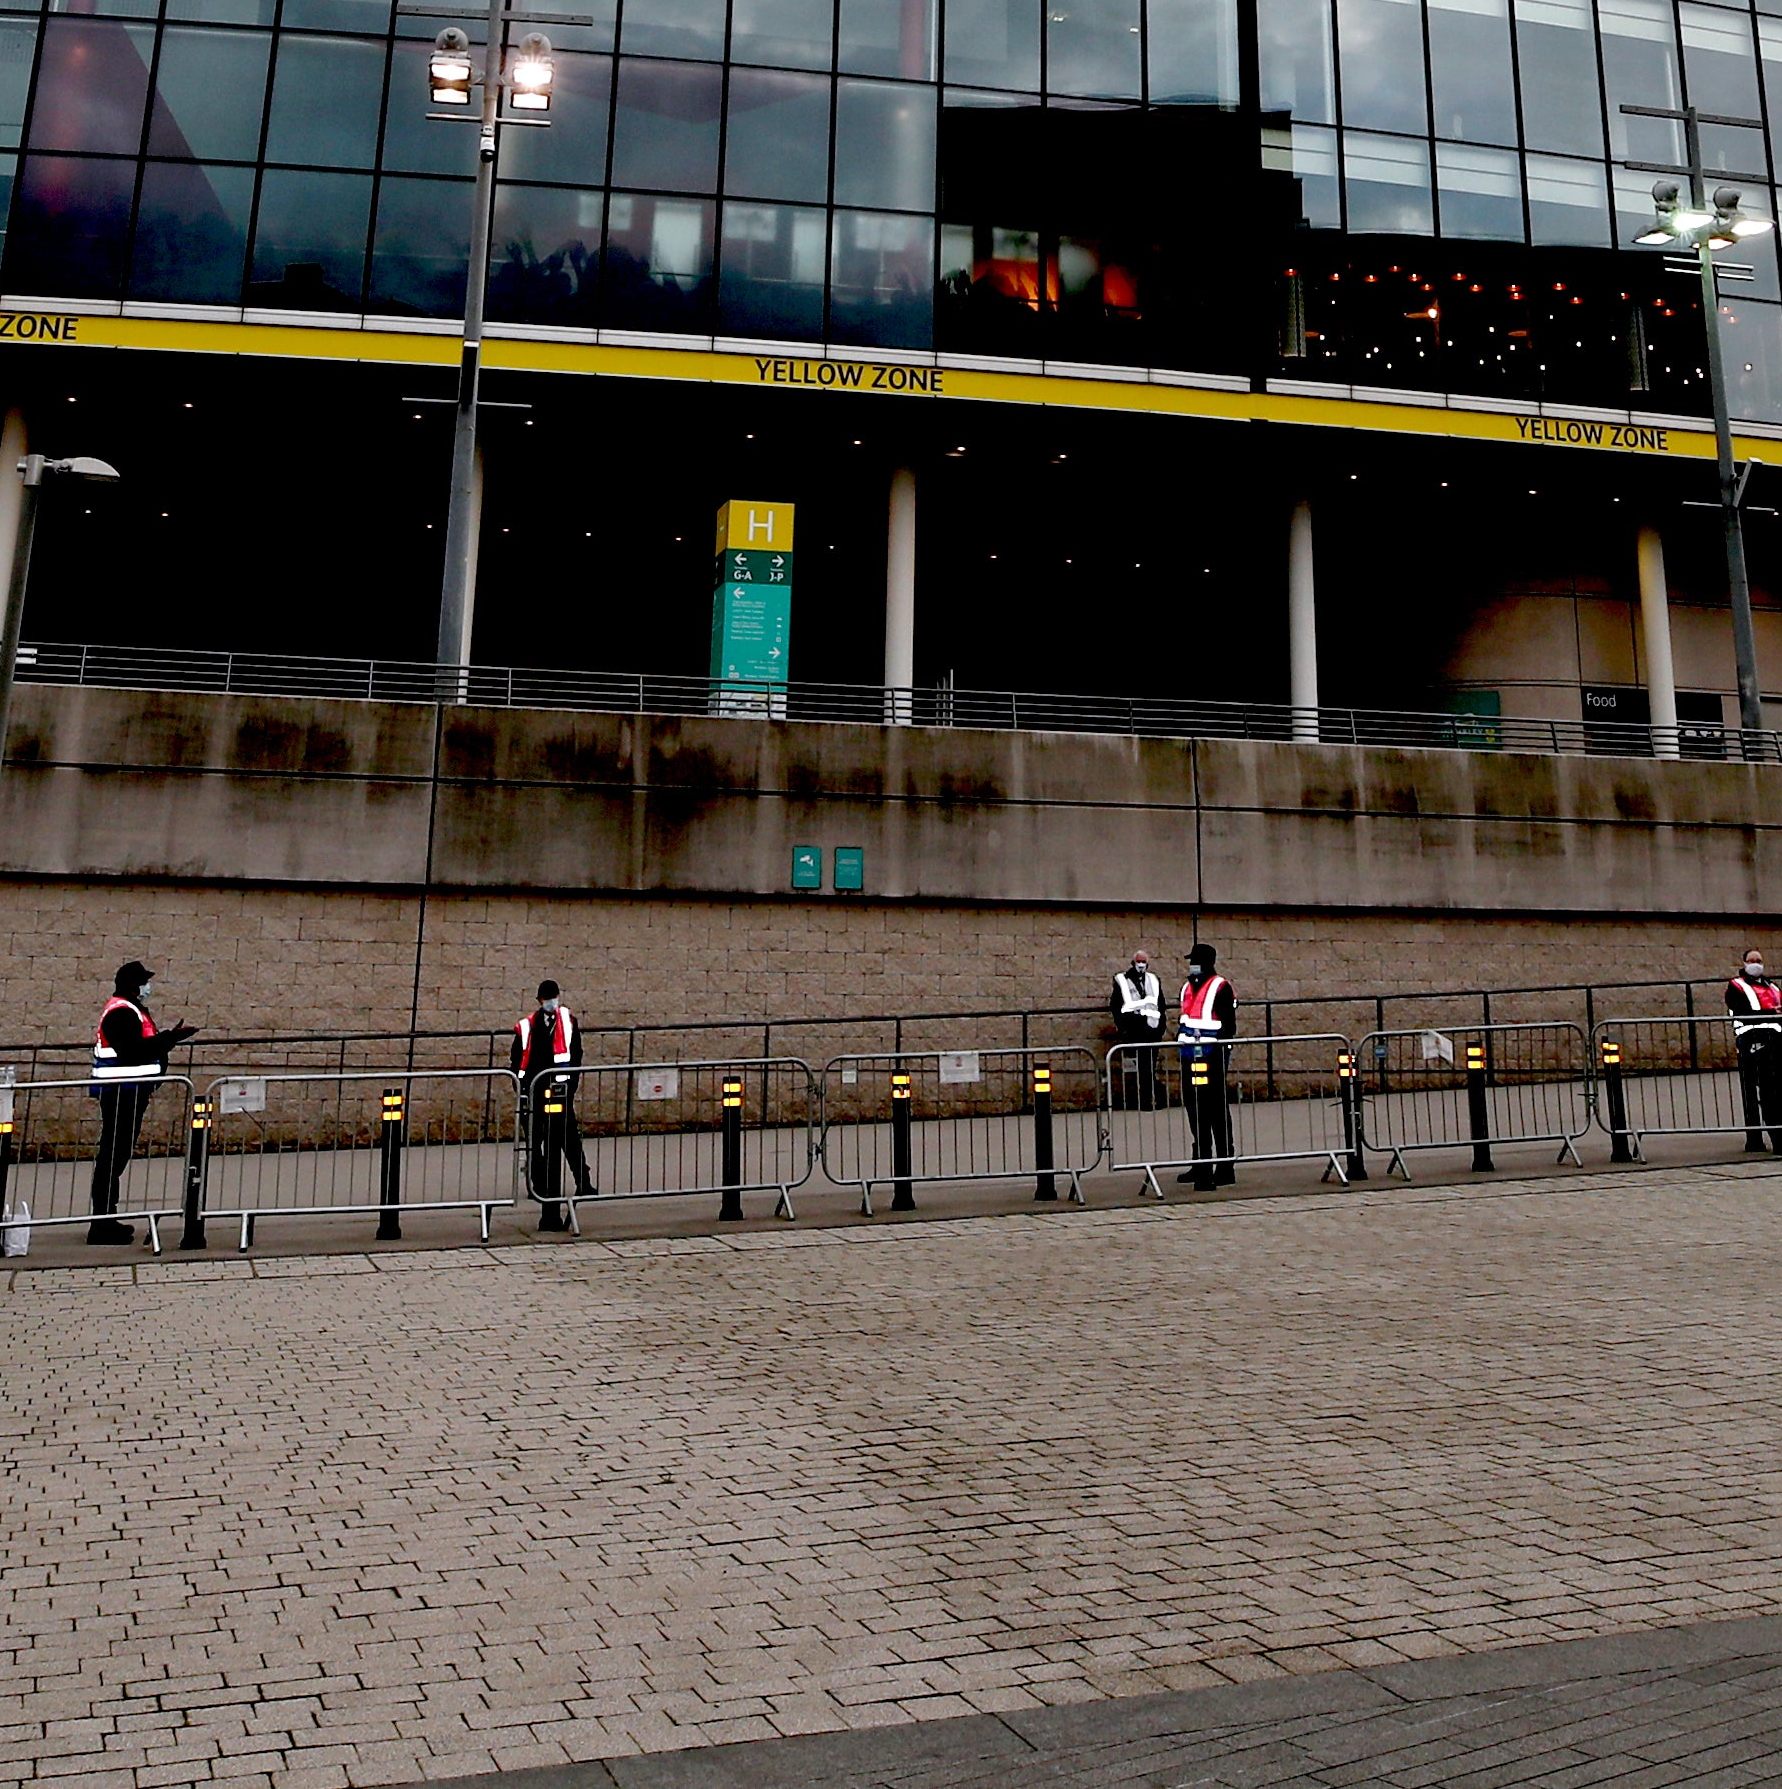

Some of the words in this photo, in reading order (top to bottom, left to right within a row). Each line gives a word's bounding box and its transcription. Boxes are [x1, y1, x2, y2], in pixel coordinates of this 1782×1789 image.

[755, 359, 864, 387] YELLOW
[871, 366, 943, 392] ZONE
[1516, 418, 1603, 444] YELLOW
[1610, 426, 1669, 450] ZONE
[748, 509, 774, 543] H
[733, 570, 753, 580] G-A
[1587, 693, 1616, 707] Food
